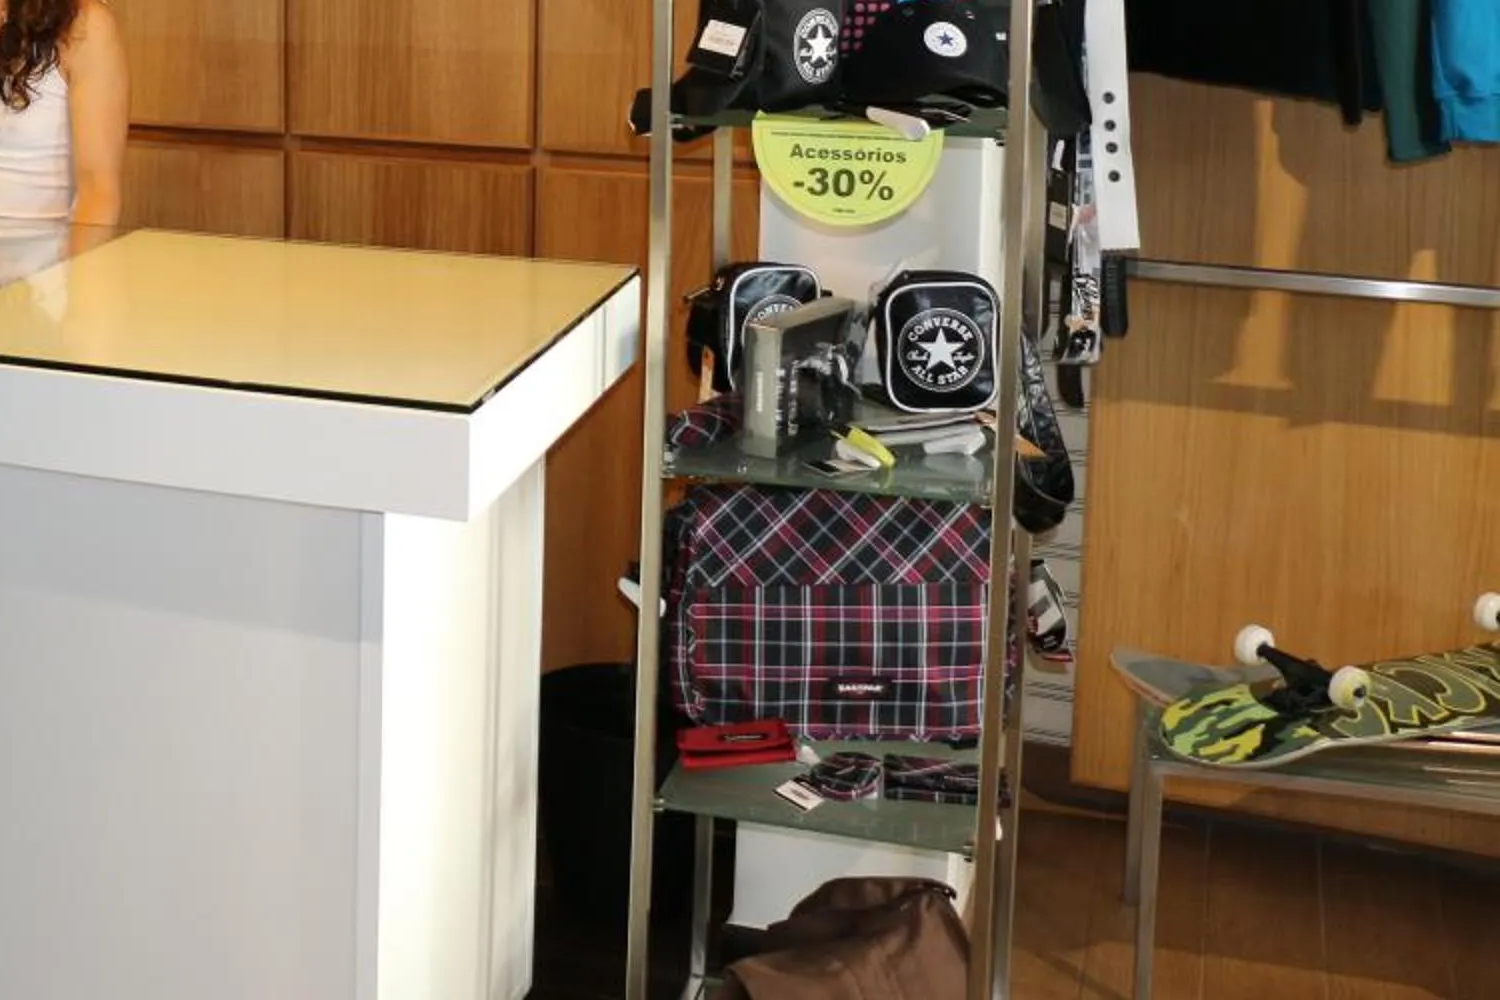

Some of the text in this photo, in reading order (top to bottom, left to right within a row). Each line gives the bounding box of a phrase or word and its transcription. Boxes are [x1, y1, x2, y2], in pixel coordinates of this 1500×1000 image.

[789, 142, 907, 164] Acessórios
[792, 166, 895, 201] -30%
[907, 316, 974, 342] CONVERSE
[911, 365, 969, 385] ALL STAR
